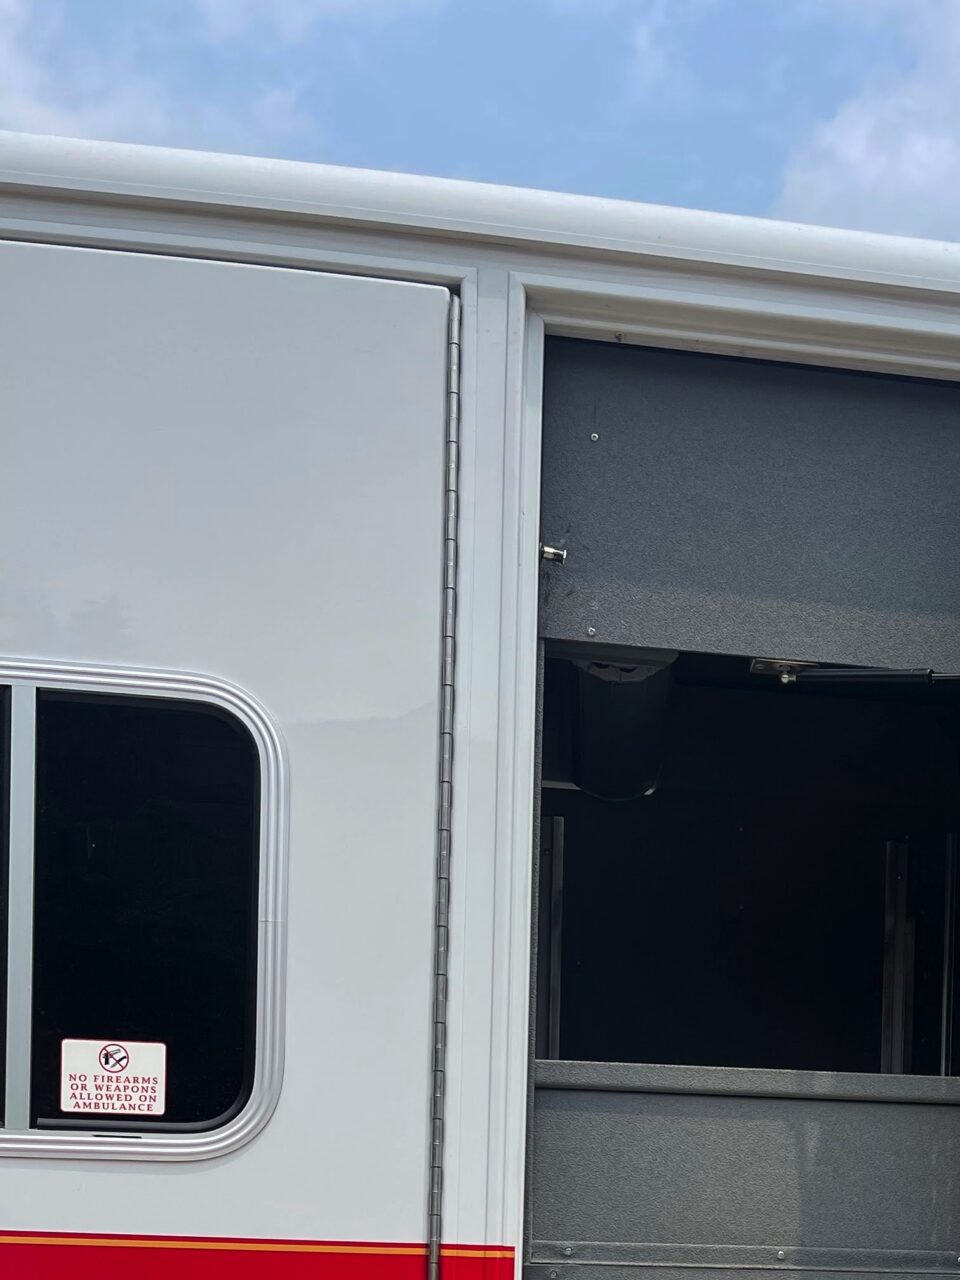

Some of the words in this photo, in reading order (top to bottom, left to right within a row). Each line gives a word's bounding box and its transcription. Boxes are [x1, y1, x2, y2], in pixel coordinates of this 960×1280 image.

[69, 1074, 87, 1082] NO
[94, 1075, 158, 1084] FIREARMS
[70, 1083, 87, 1091] OR
[95, 1084, 156, 1093] WEAPONS
[69, 1093, 132, 1101] ALLOWED
[139, 1095, 156, 1103] ON
[73, 1102, 153, 1111] AMBULANCE
